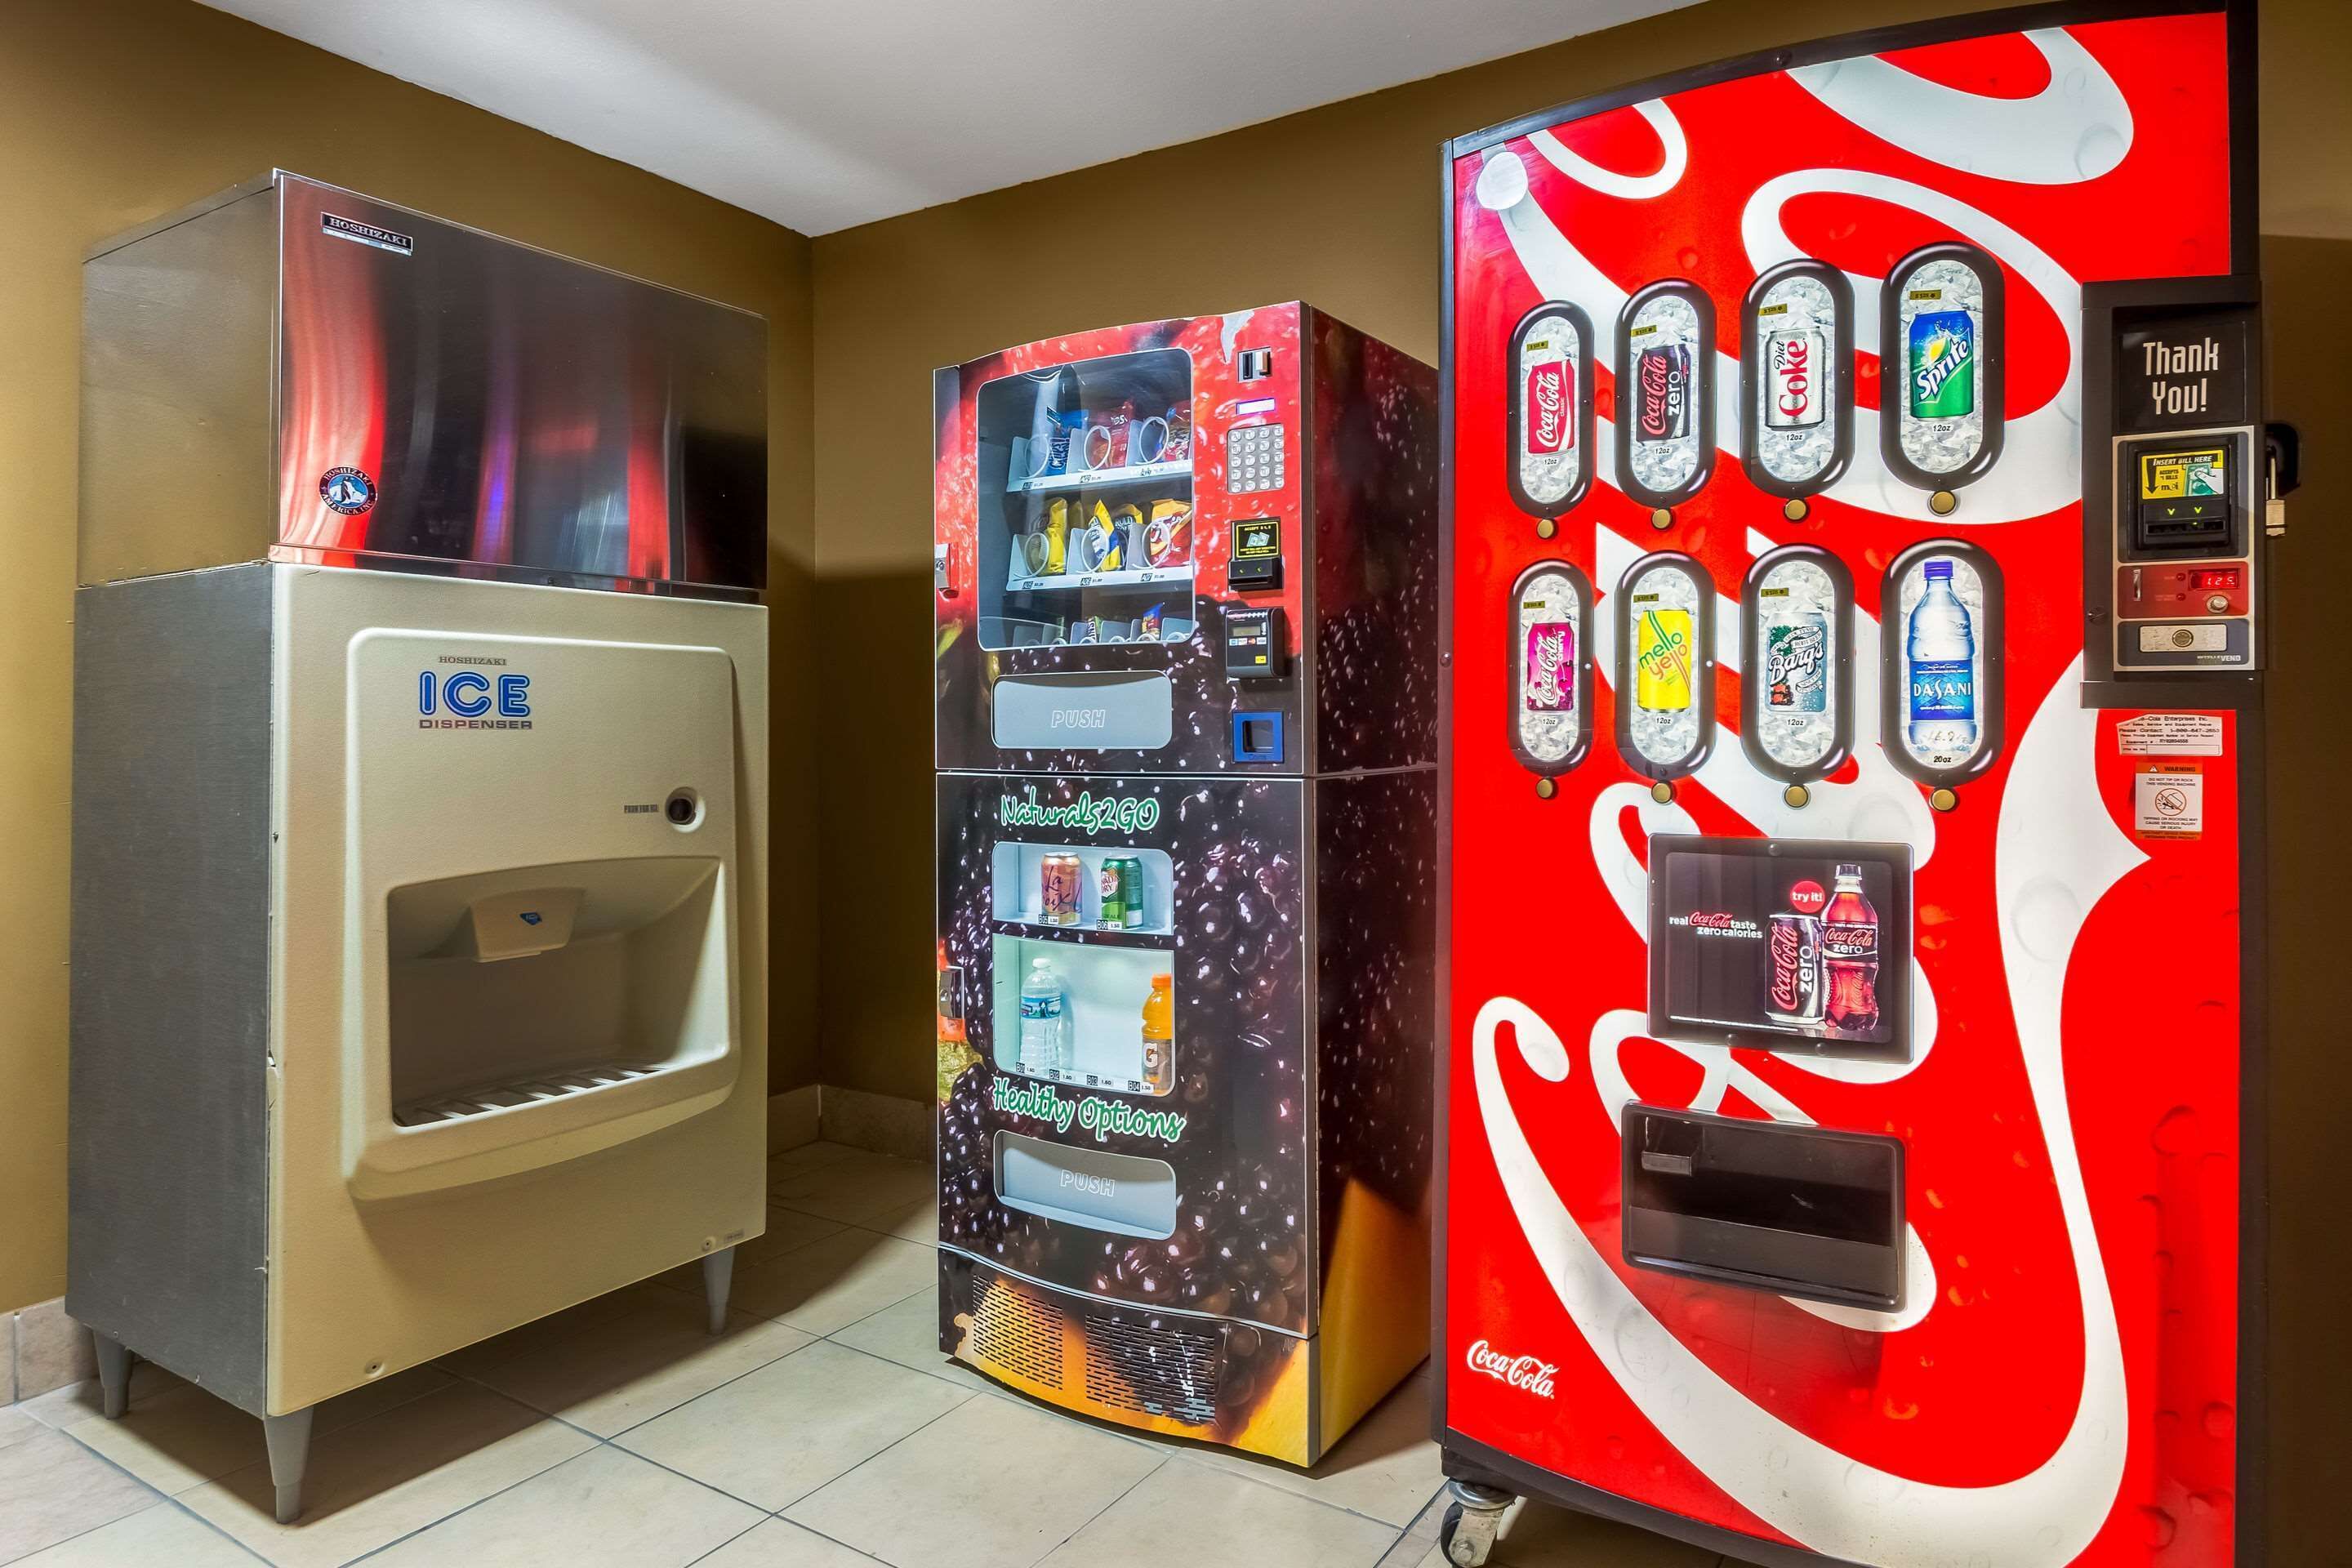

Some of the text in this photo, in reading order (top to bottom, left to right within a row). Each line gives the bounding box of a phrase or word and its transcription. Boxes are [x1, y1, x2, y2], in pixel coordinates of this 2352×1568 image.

[328, 217, 408, 247] HOSHIZAKI
[1773, 341, 1784, 370] Diet
[1916, 337, 1970, 400] Sprite
[2142, 337, 2220, 376] Thank
[1779, 339, 1808, 417] Coke
[1642, 354, 1668, 435] Coca-Cola
[1668, 371, 1681, 416] zero
[2152, 378, 2207, 415] You!
[1535, 370, 1560, 448] Coca-Cola
[1786, 433, 1803, 442] 12oz
[1932, 423, 1951, 433] 12oz
[1655, 446, 1670, 455] 12oz
[324, 467, 372, 486] HOSHIZAKI
[438, 656, 508, 666] HOSHIZAKI
[1639, 632, 1682, 670] mello
[1648, 643, 1688, 680] yello
[1768, 641, 1824, 686] Barq's
[419, 670, 531, 718] ICE
[1913, 679, 1971, 700] DASANI
[419, 719, 532, 729] DISPENSER
[1051, 709, 1106, 728] PUSH
[1542, 717, 1556, 725] 12oz
[1655, 716, 1671, 724] 12oz
[1787, 718, 1804, 726] 12oz
[1000, 785, 1160, 835] Naturals2GO
[1792, 891, 1823, 903] try it!
[1668, 911, 1757, 929] real Coca-Cola taste
[1696, 927, 1763, 938] zero calories
[1825, 928, 1874, 947] Coca-Cola
[1833, 944, 1863, 954] zero
[1799, 945, 1813, 993] zero
[1143, 1042, 1158, 1067] G
[1128, 1080, 1140, 1092] B04
[993, 1077, 1187, 1143] Healthy Options
[1060, 1169, 1116, 1196] PUSH
[1467, 1339, 1561, 1400] Coca-Cola
